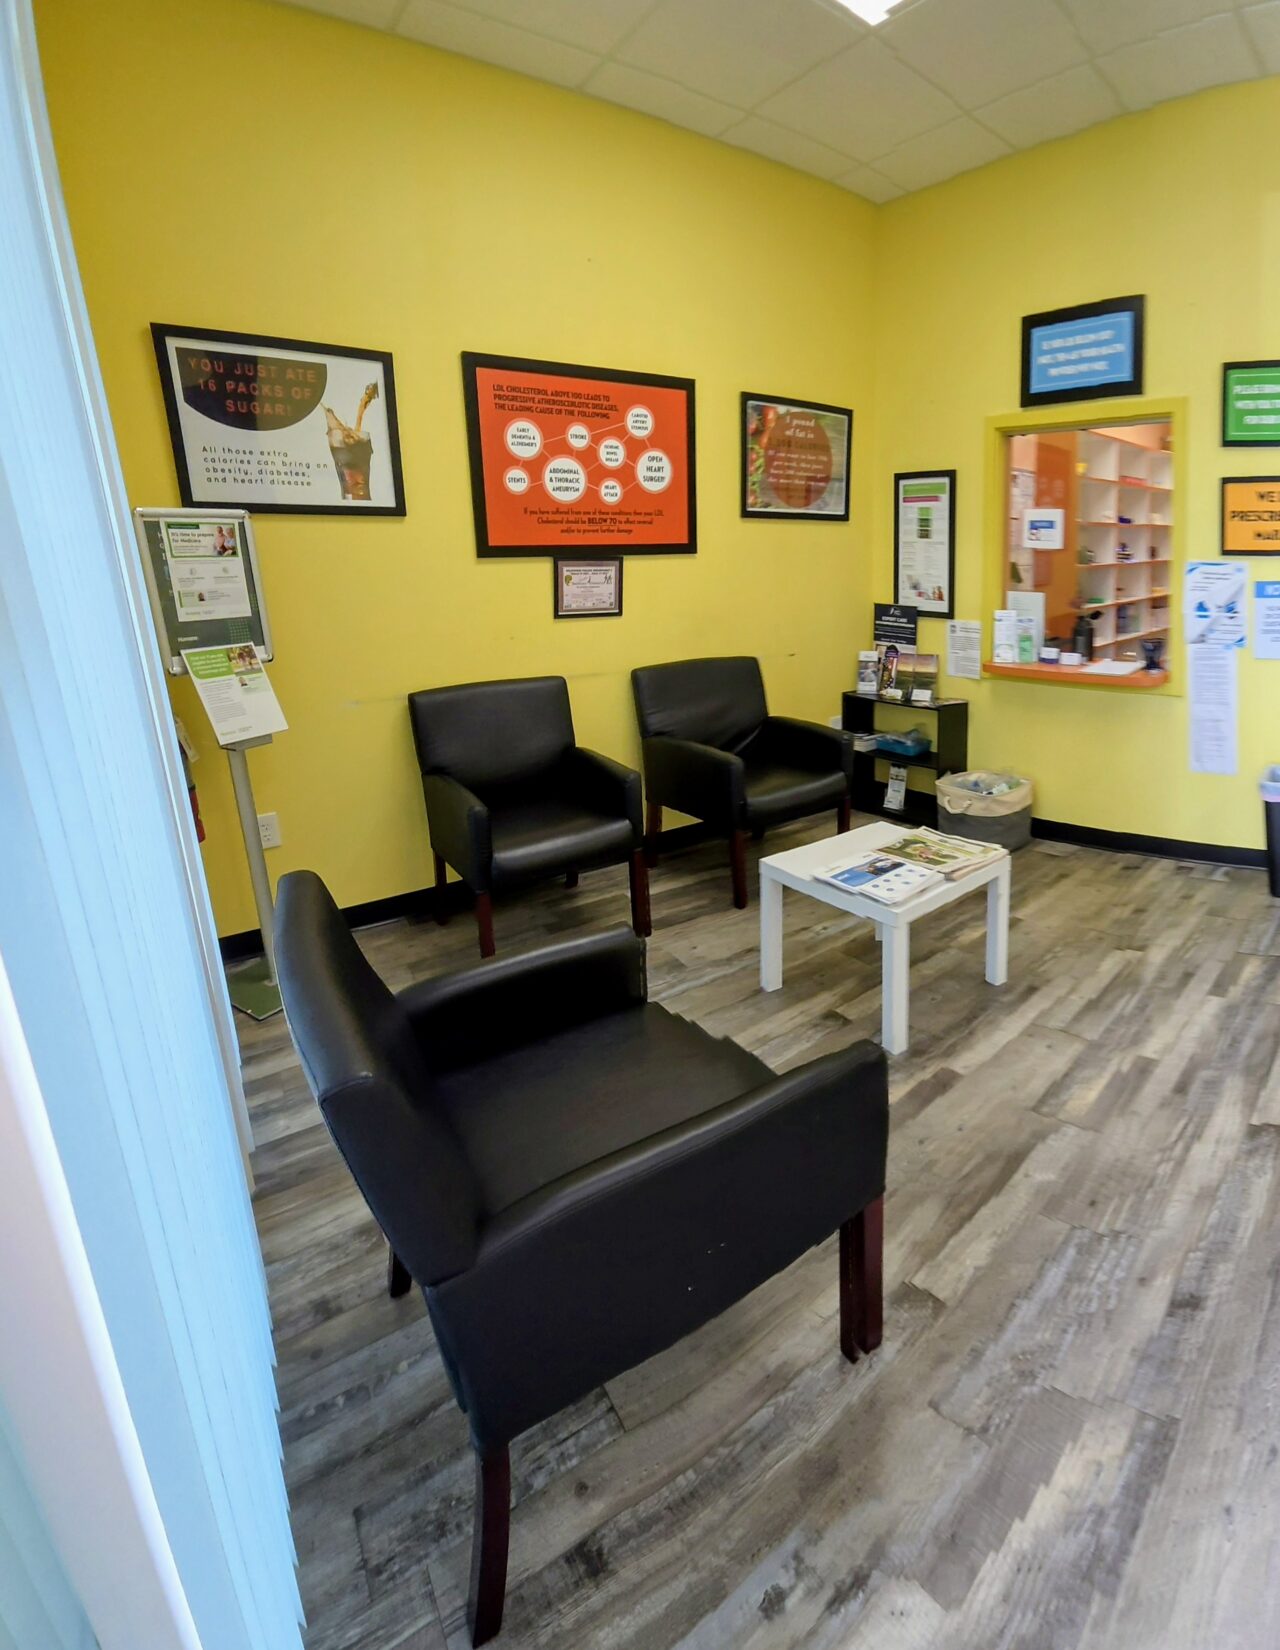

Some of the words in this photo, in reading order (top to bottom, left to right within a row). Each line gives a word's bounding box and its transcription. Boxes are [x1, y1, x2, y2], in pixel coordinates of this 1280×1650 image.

[188, 357, 224, 373] YOU
[234, 363, 277, 378] JUST
[286, 367, 316, 382] ATE
[198, 379, 216, 392] 16
[225, 380, 284, 397] PACKS
[291, 387, 311, 400] OF
[506, 385, 549, 396] CHOLESTEROL
[550, 390, 570, 399] ABOVE
[571, 391, 582, 400] 100
[583, 393, 601, 401] LEADS
[493, 393, 535, 404] PROGRESSIVE
[494, 403, 507, 411] THE
[508, 404, 534, 413] LEADING
[535, 406, 554, 415] CAUSE
[222, 447, 253, 455] those
[203, 457, 251, 465] calories
[282, 460, 310, 469] bring
[205, 466, 253, 476] obesity,
[258, 468, 310, 478] diabetes,
[1255, 491, 1276, 502] WE
